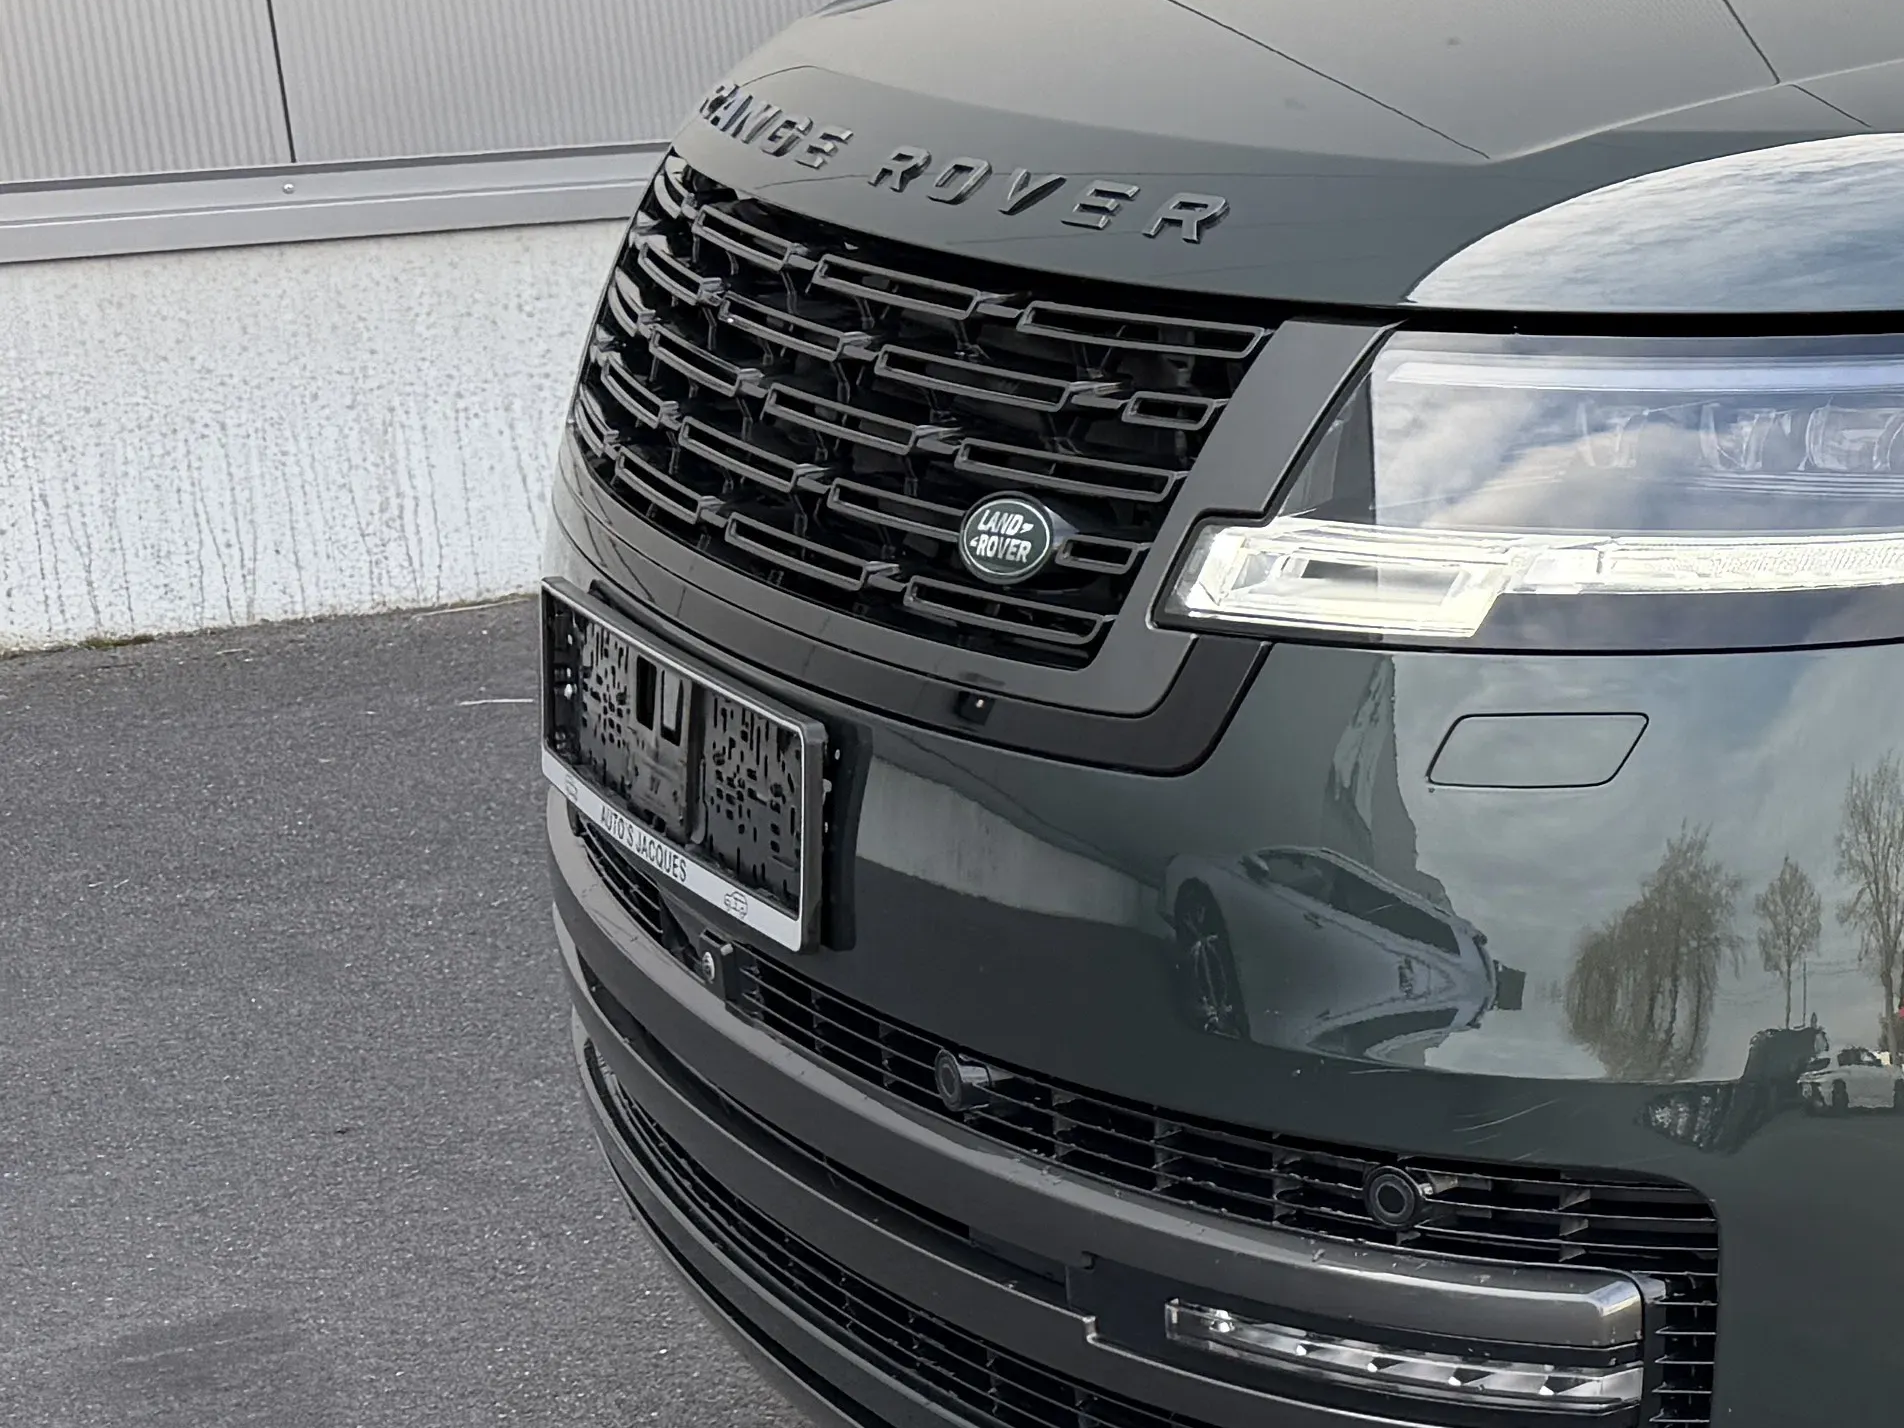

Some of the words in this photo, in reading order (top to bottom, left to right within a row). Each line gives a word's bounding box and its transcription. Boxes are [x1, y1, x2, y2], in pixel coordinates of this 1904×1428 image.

[867, 144, 1230, 244] ROVER
[976, 509, 1021, 535] LAND
[974, 536, 1032, 565] ROVER
[600, 805, 634, 847] AUTO'S
[635, 830, 688, 883] JACQUES
